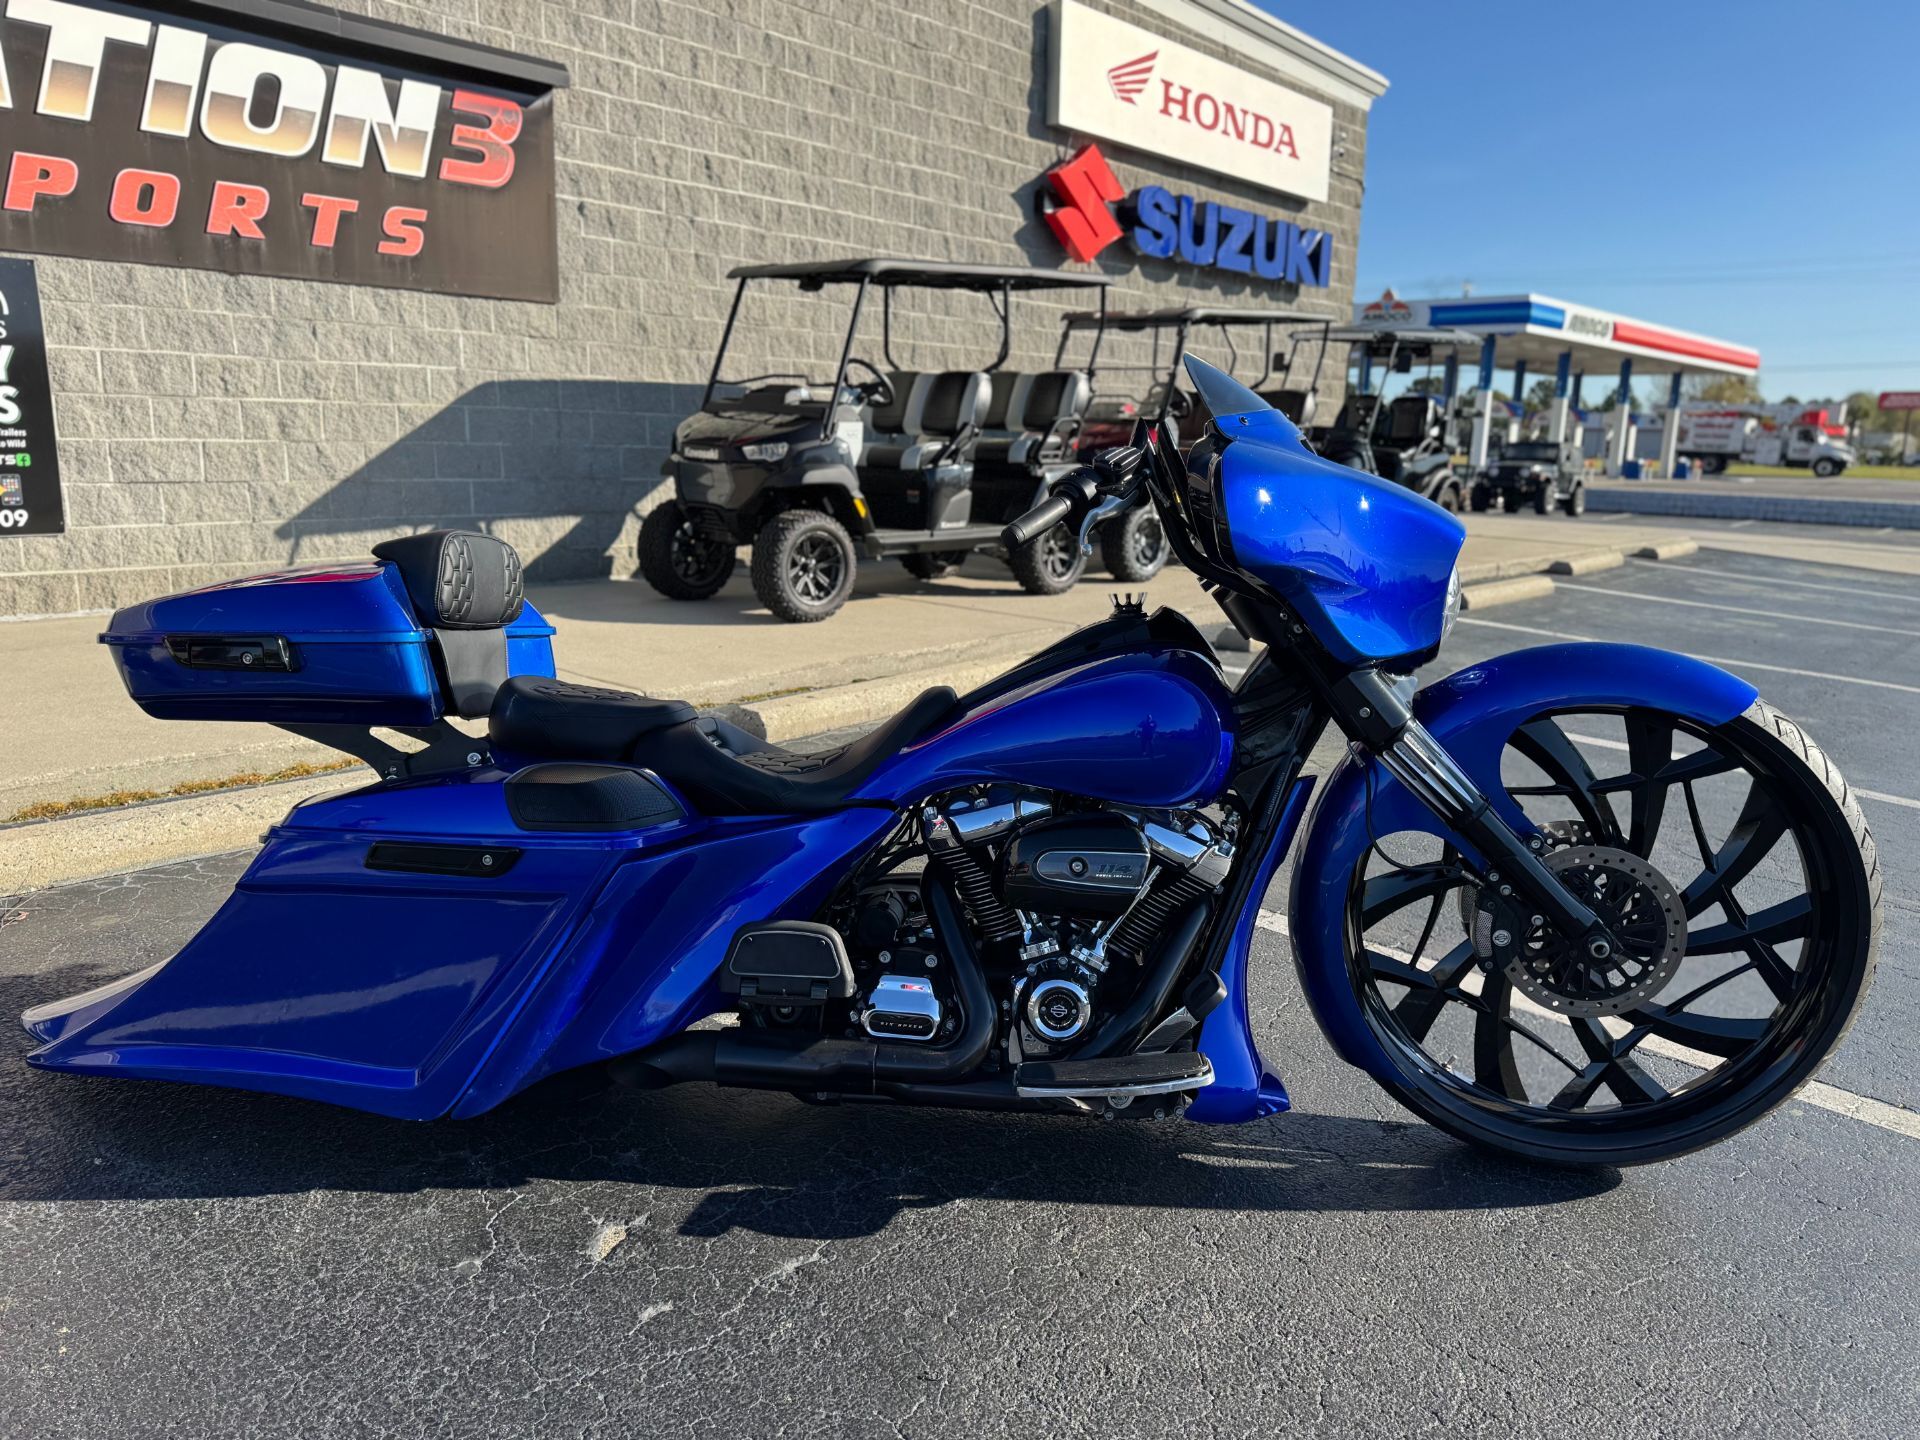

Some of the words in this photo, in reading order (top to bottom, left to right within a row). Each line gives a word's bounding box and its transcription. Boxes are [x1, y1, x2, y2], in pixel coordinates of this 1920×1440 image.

[1159, 79, 1300, 160] HONDA
[3, 151, 428, 257] PORTS
[1133, 185, 1334, 288] SUZUKI
[0, 428, 27, 437] railers
